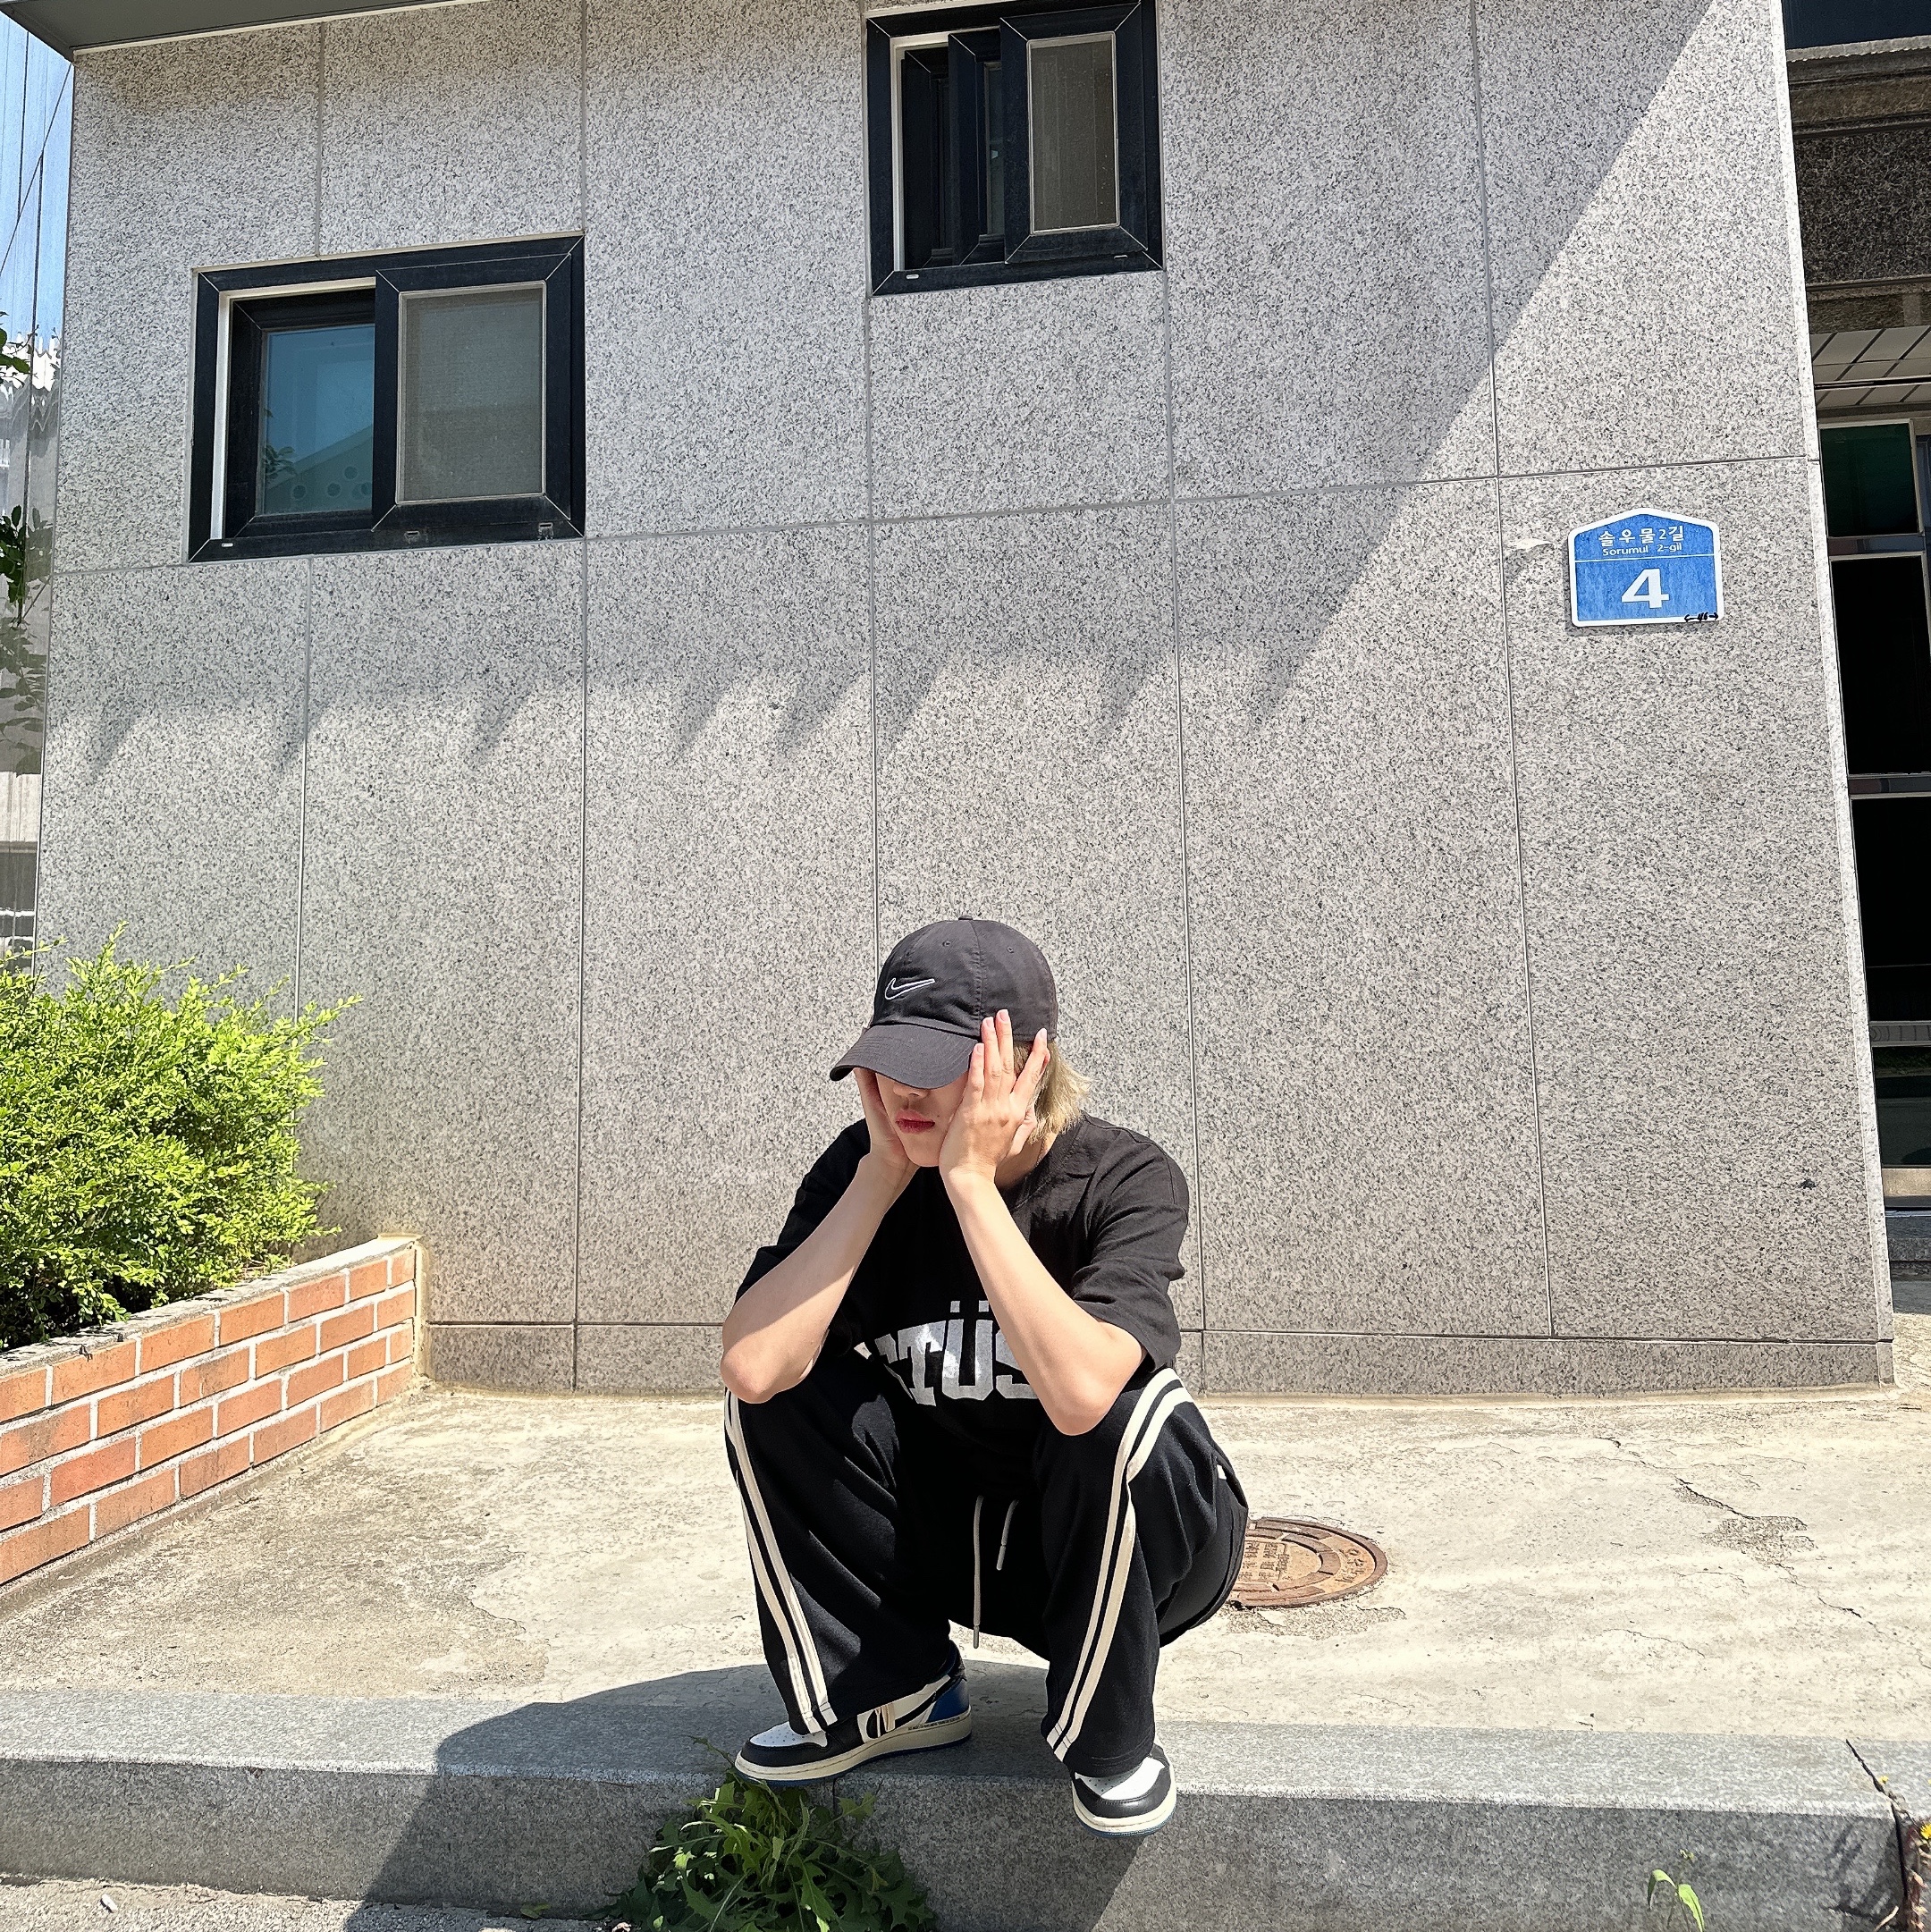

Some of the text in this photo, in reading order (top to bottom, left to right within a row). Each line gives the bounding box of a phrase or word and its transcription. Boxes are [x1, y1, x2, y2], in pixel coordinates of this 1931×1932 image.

[1602, 543, 1682, 556] Sorumul 2-gil
[1621, 568, 1669, 609] 4
